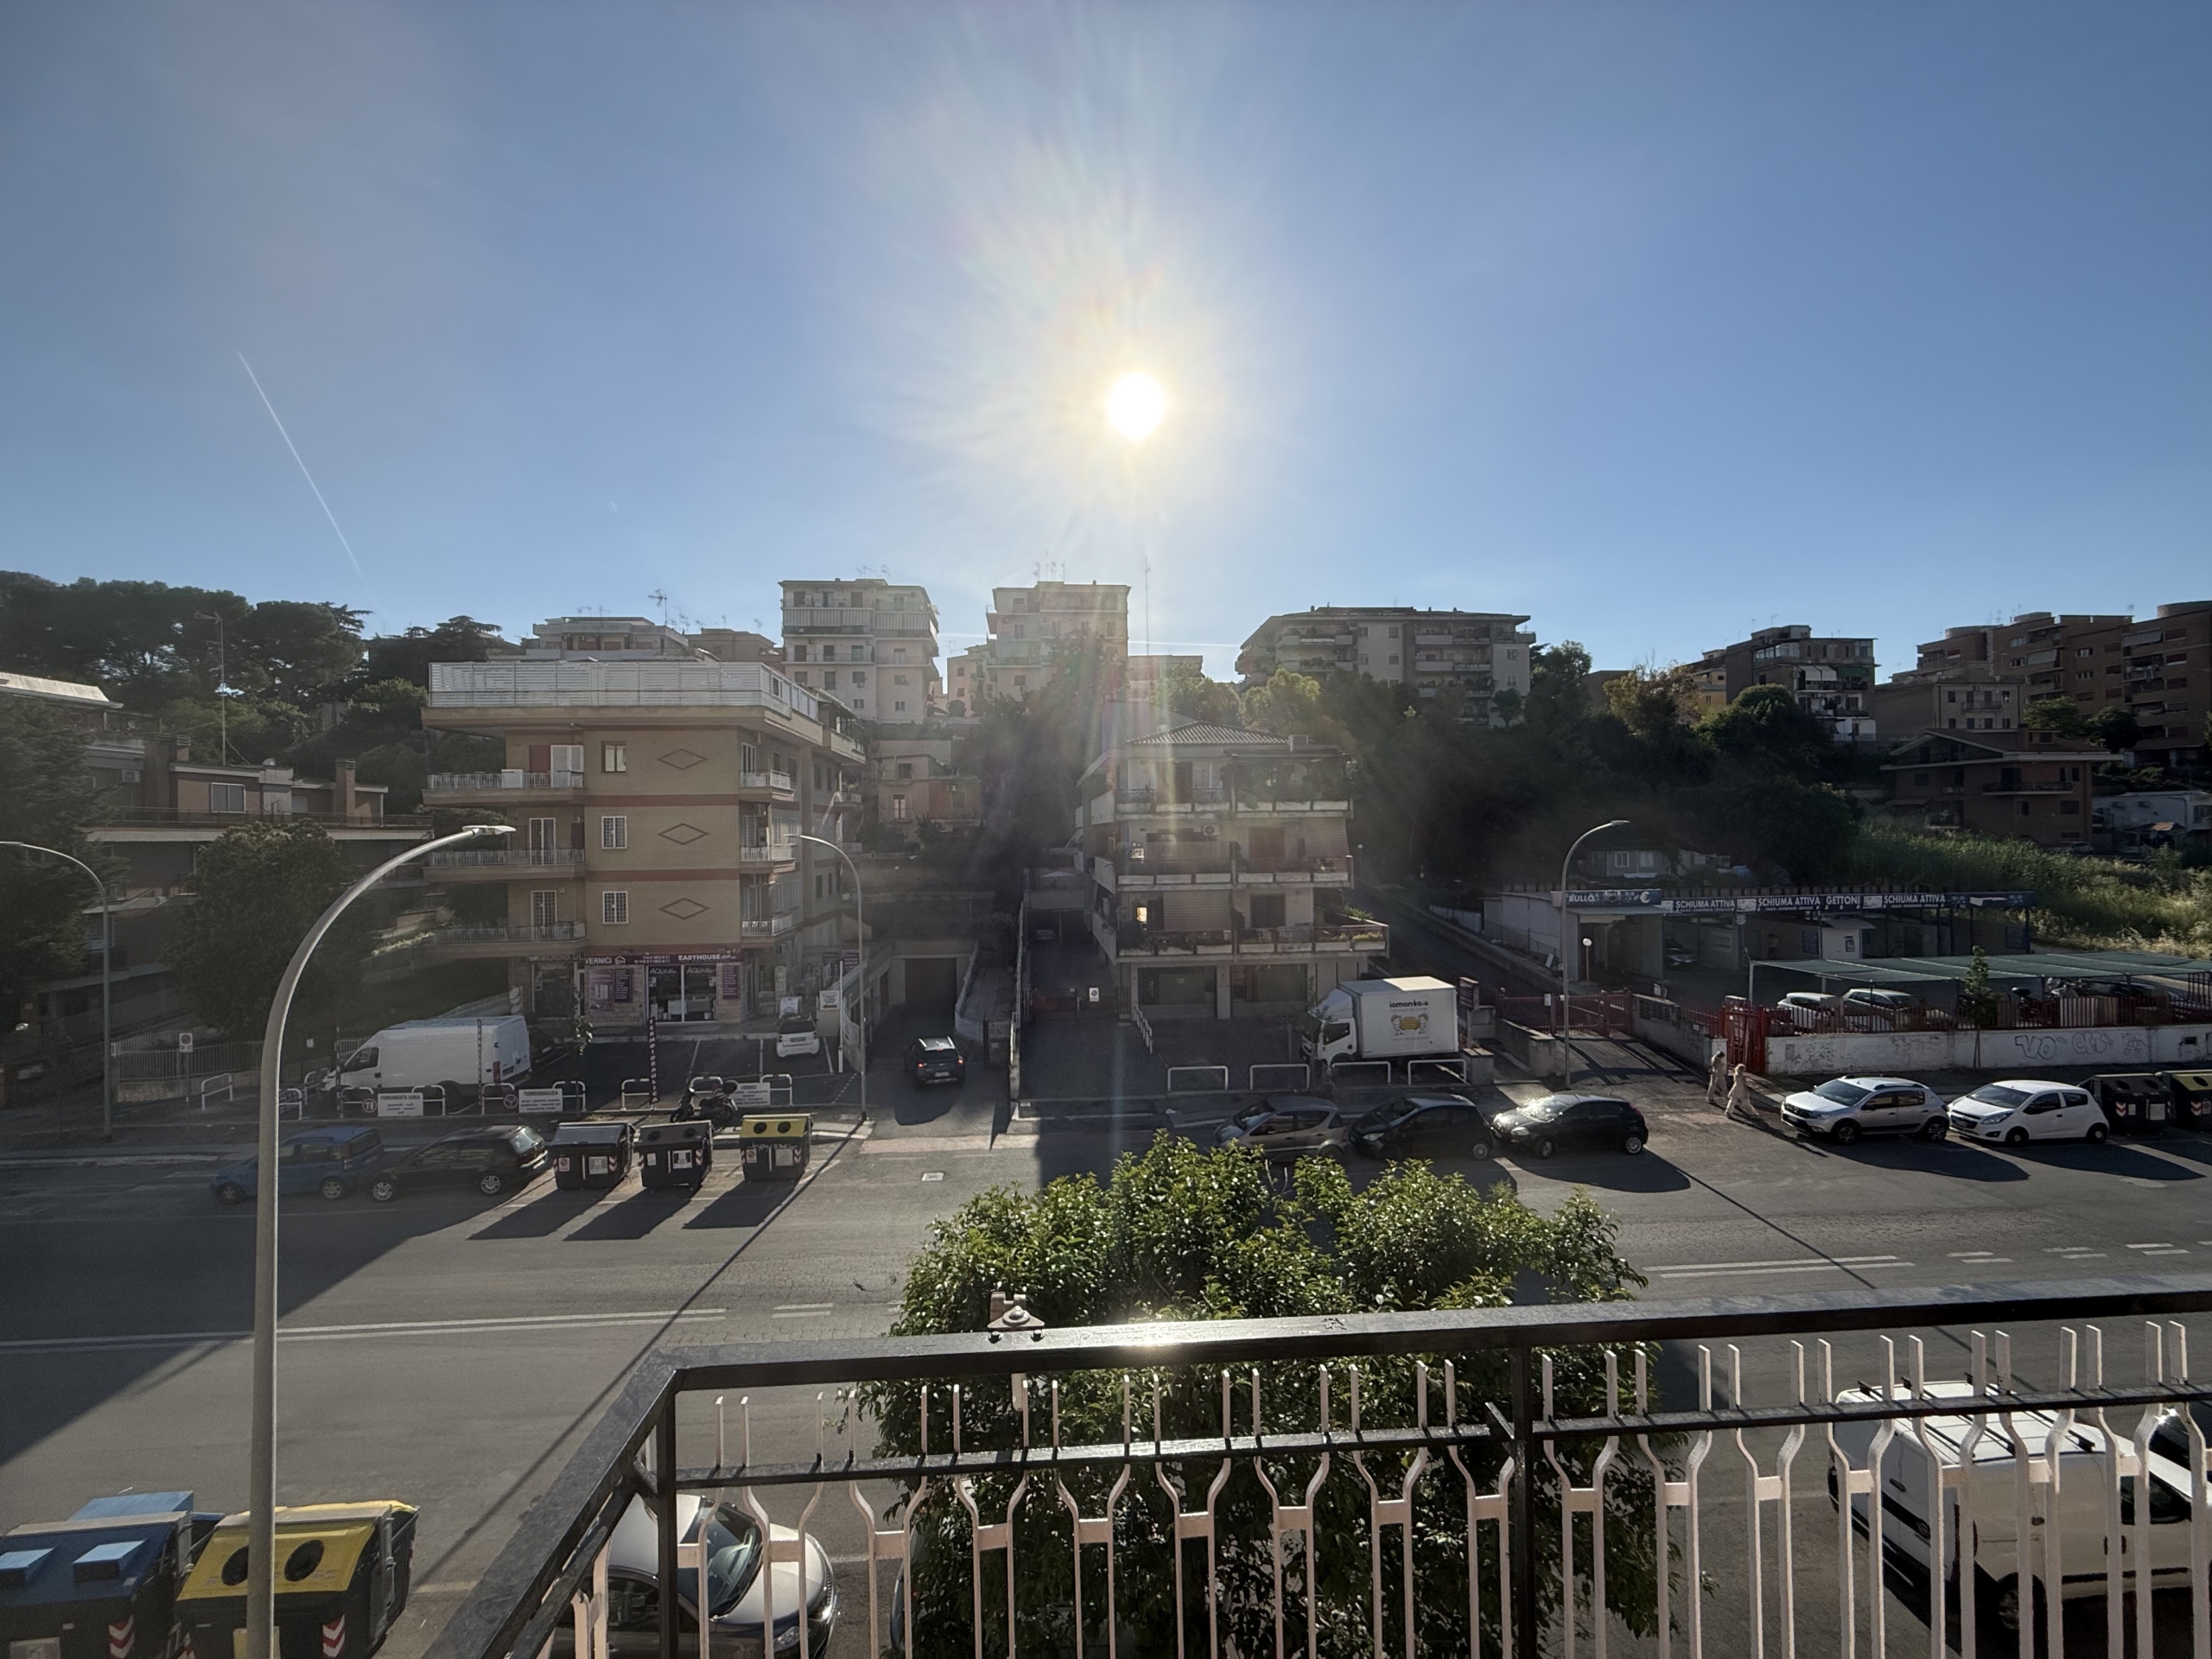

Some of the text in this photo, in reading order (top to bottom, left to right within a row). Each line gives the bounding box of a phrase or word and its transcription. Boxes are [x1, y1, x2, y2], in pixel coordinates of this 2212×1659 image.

[1640, 891, 1650, 903] €
[1758, 896, 1821, 906] SCHIUMA ATTIVA
[1826, 895, 1860, 905] GETTONI
[1884, 894, 1945, 904] SCHIUMA ATTIVA
[1675, 899, 1709, 908] SCHIUMA
[648, 1019, 658, 1103] TERMOIDRAULICA
